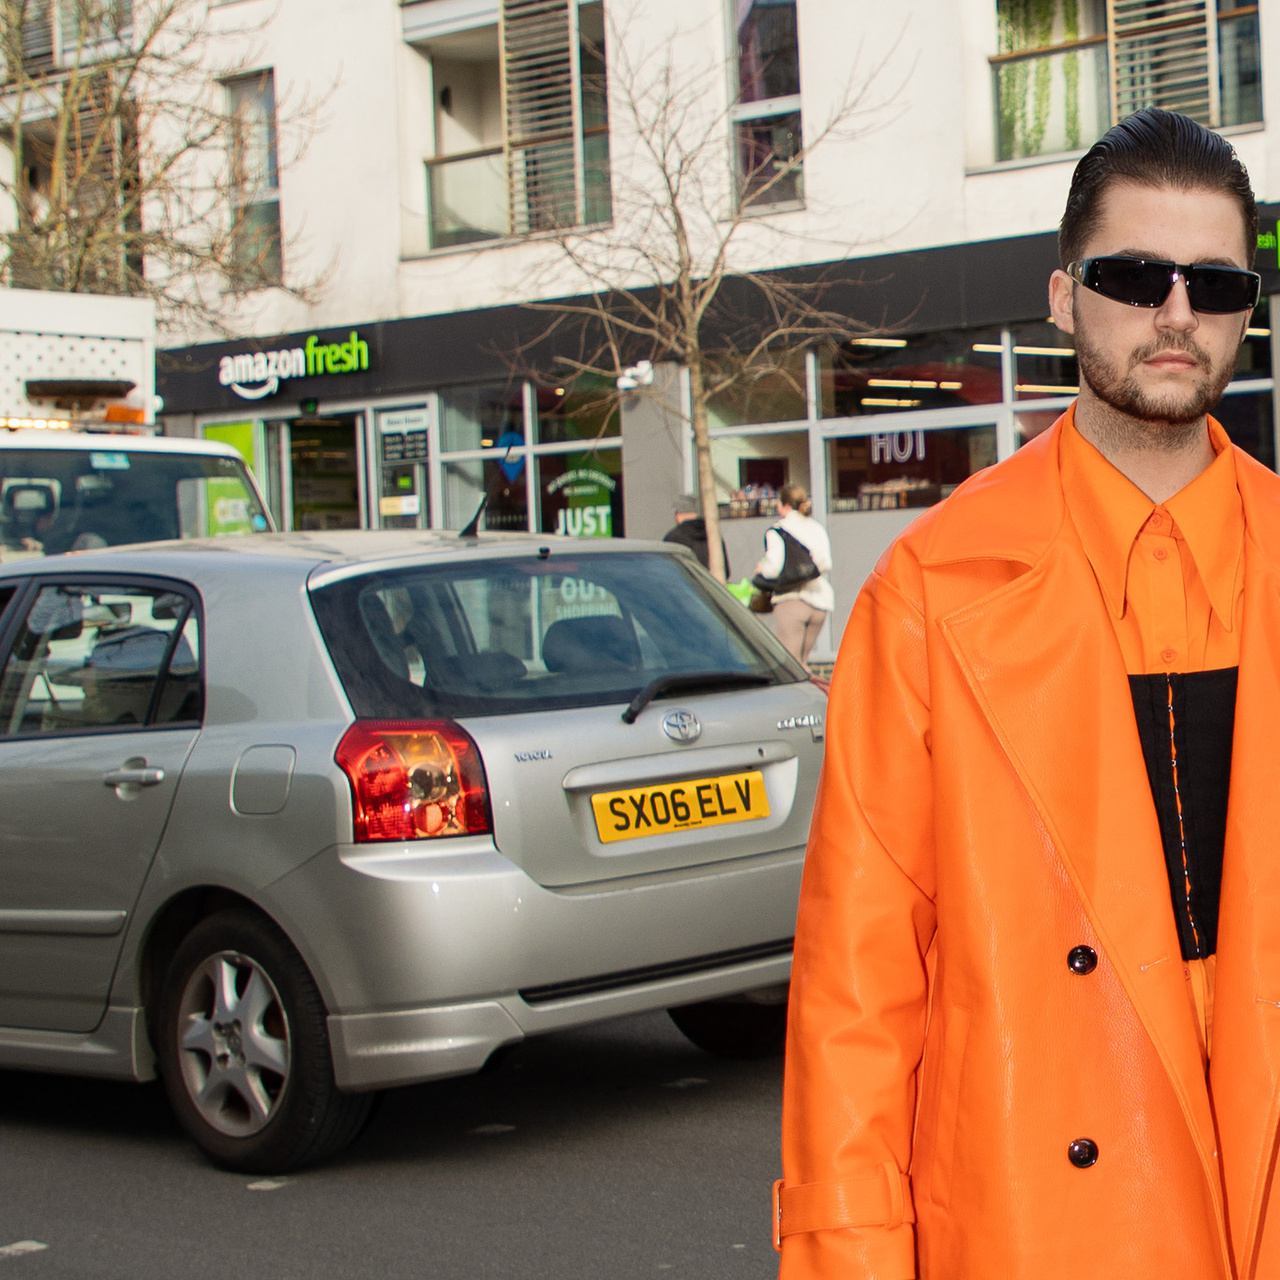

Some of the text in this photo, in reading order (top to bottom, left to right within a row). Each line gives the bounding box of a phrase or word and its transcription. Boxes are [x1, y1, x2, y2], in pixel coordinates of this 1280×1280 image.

[1257, 231, 1276, 249] esh
[554, 505, 612, 536] JUST
[609, 778, 751, 832] SX06 ELV
